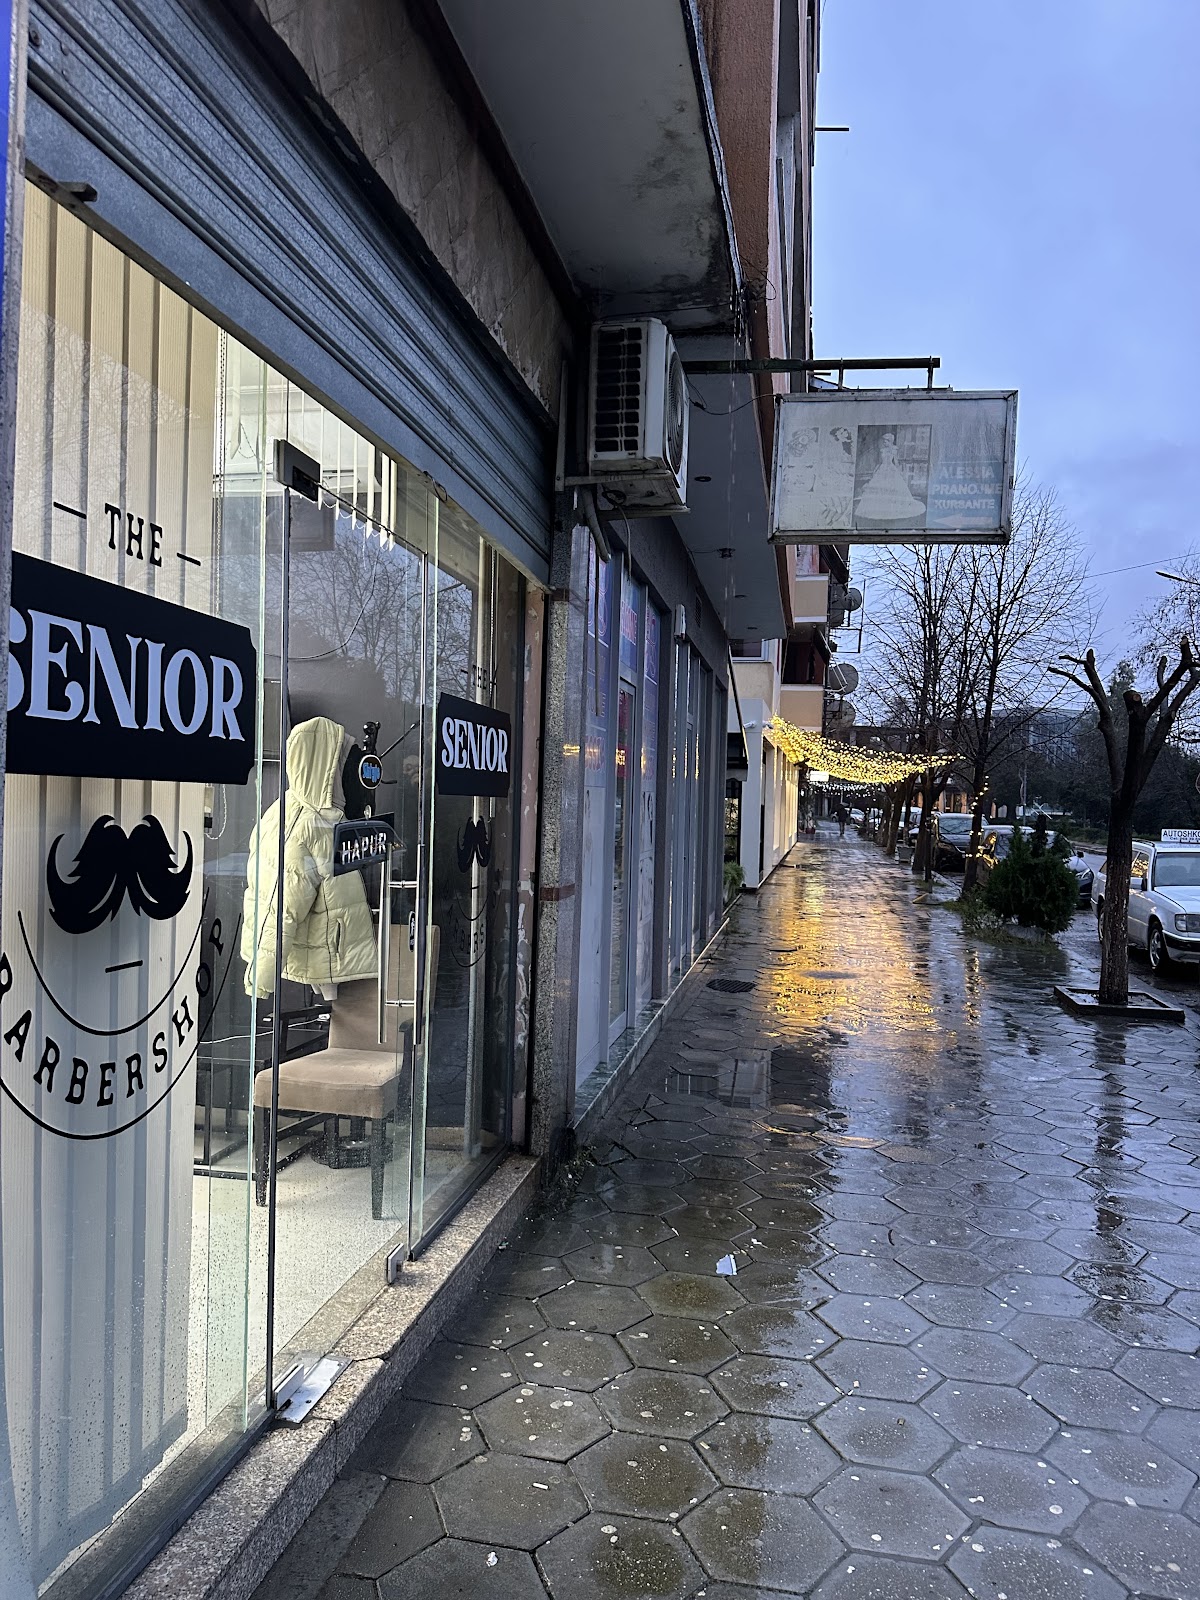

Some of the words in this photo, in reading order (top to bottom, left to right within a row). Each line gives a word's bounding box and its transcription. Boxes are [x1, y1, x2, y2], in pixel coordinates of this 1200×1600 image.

[104, 502, 163, 567] THE
[472, 664, 488, 690] THE
[441, 716, 508, 773] SENIOR
[342, 832, 387, 866] HAPUR
